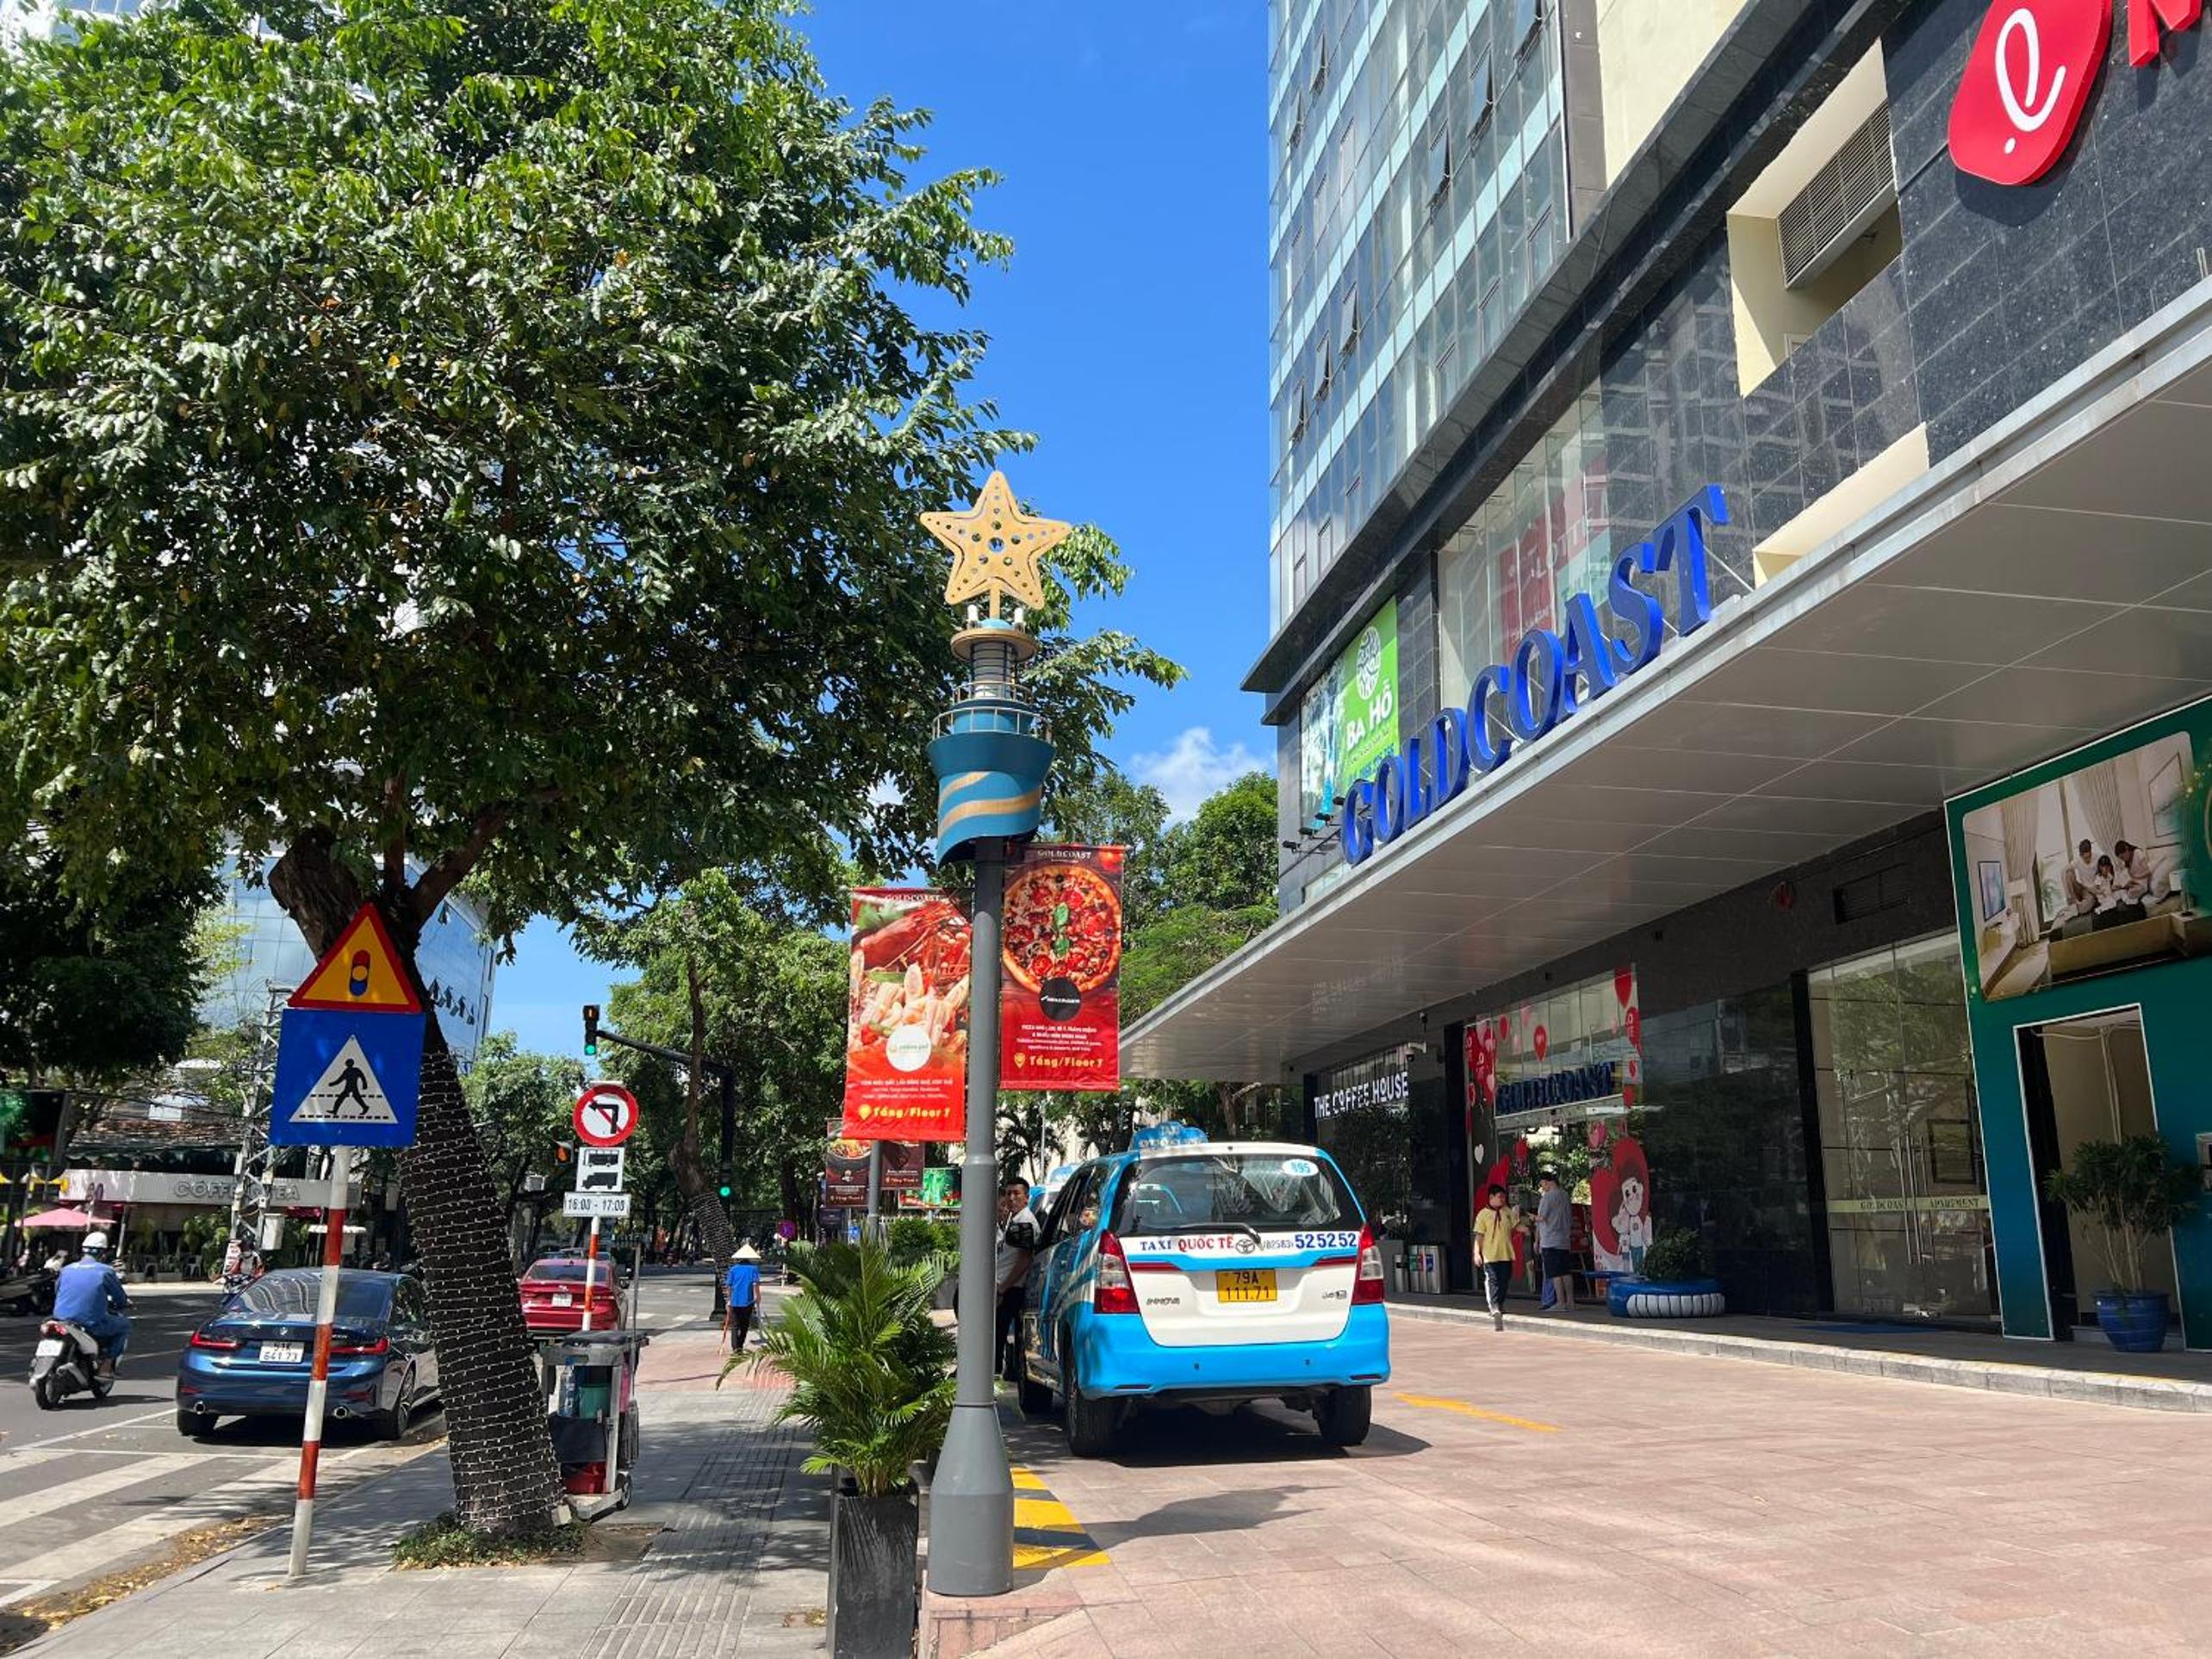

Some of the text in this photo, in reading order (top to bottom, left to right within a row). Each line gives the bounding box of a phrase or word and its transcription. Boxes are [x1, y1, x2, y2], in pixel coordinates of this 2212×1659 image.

[1341, 483, 1730, 866] GOLDCOAST
[1346, 717, 1366, 752] BA
[1037, 849, 1091, 859] GOLDCOAST
[1314, 1071, 1409, 1119] THE COFFEE HOUSE
[1140, 1240, 1172, 1251] TAXI
[1233, 1271, 1259, 1285] 79A
[1226, 1285, 1271, 1301] 111.71
